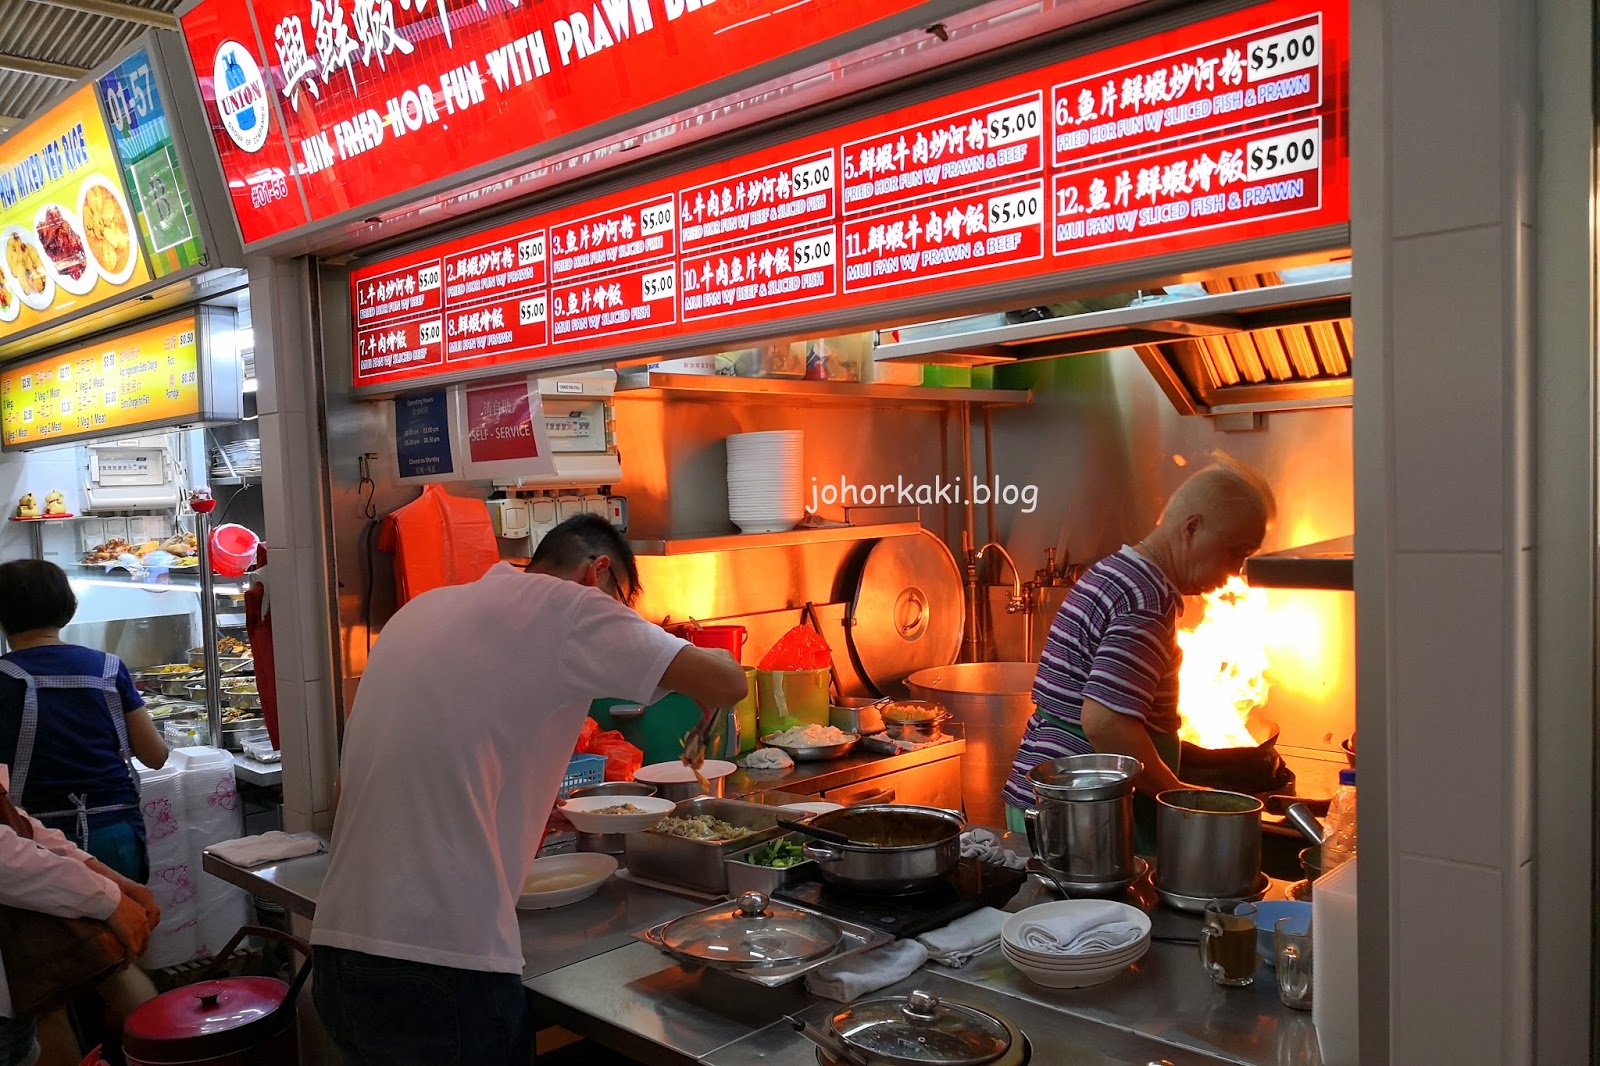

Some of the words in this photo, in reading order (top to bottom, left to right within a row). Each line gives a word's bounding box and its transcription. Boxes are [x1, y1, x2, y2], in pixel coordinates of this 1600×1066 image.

[1251, 35, 1315, 70] $5.00
[333, 109, 384, 160] FRIED
[386, 84, 439, 138] HOR
[439, 60, 485, 114] FUN
[485, 29, 550, 93] WITH
[554, 0, 653, 66] PRAWN
[106, 63, 154, 132] 01-57
[220, 80, 262, 116] UNION
[990, 110, 1036, 140] $5.00
[1057, 128, 1088, 152] FRIED
[1090, 121, 1116, 144] HOR
[1117, 115, 1142, 137] FUN
[1144, 110, 1163, 133] W/
[1213, 90, 1243, 114] FISH
[1244, 87, 1257, 107] &
[1258, 74, 1310, 103] PRAWN
[228, 121, 244, 142] GROUP
[14, 153, 44, 200] MIXED
[42, 140, 64, 182] VEG
[62, 123, 88, 172] RICE
[1251, 138, 1314, 171] $5.00
[794, 166, 829, 191] $5.00
[845, 180, 873, 203] FRIED
[875, 174, 896, 196] HOR
[898, 169, 921, 191] FUN
[924, 164, 940, 187] W/
[942, 154, 984, 180] PRAWN
[986, 151, 996, 170] &
[997, 144, 1027, 168] BEEF
[252, 177, 288, 208] #01-56
[643, 209, 670, 229] $5.00
[683, 224, 702, 242] FRIED
[704, 219, 720, 237] HOR
[721, 215, 737, 233] FUN
[738, 212, 749, 230] W/
[751, 208, 769, 226] BEEF
[770, 206, 777, 221] &
[778, 199, 806, 219] SLICED
[807, 194, 826, 212] FISH
[991, 197, 1037, 224] $5.00
[1058, 219, 1085, 241] MUI
[1086, 214, 1114, 236] FAN
[1117, 210, 1137, 232] W/
[1139, 200, 1190, 226] SLICED
[1191, 193, 1227, 217] FISH
[1229, 190, 1242, 210] &
[1243, 178, 1304, 208] PRAWN
[520, 243, 542, 260] $5.00
[554, 256, 572, 274] FRIED
[574, 252, 589, 269] HOR
[590, 248, 606, 265] FUN
[606, 246, 617, 263] W/
[619, 240, 644, 259] SLICED
[646, 235, 664, 252] FISH
[795, 241, 830, 264] $5.00
[847, 260, 871, 281] MUI
[873, 255, 898, 276] FAN
[900, 252, 919, 273] W/
[922, 242, 971, 268] PRAWN
[973, 239, 985, 258] &
[987, 233, 1021, 256] BEEF
[419, 272, 438, 288] $5.00
[447, 283, 465, 298] FRIED
[466, 279, 480, 294] HOR
[481, 276, 495, 290] FUN
[496, 273, 506, 288] W/
[508, 266, 533, 284] PRAWN
[644, 275, 673, 295] $5.00
[685, 294, 702, 311] MUI
[703, 290, 721, 307] FAN
[723, 288, 735, 305] W/
[737, 283, 758, 301] BEEF
[760, 282, 766, 297] &
[768, 275, 800, 296] SLICED
[802, 271, 824, 289] FISH
[388, 300, 400, 313] FUN
[410, 294, 424, 308] BEEF
[521, 303, 544, 320] $5.00
[555, 319, 570, 334] MUI
[572, 316, 587, 331] FAN
[589, 314, 600, 330] W/
[602, 308, 630, 326] SLICED
[631, 305, 650, 321] FISH
[180, 332, 194, 345] $0.50
[421, 326, 439, 340] $5.00
[449, 340, 462, 353] MUI
[463, 337, 476, 350] FAN
[477, 335, 486, 349] W/
[488, 331, 512, 346] PRAWN
[393, 351, 412, 364] SLICED
[413, 348, 427, 360] BEEF
[182, 372, 195, 383] $0.50
[38, 392, 46, 403] Veg
[51, 422, 62, 432] Meat
[81, 416, 89, 428] Veg
[95, 413, 106, 424] Meat
[471, 428, 488, 442] SELF
[495, 424, 530, 439] SERVICE
